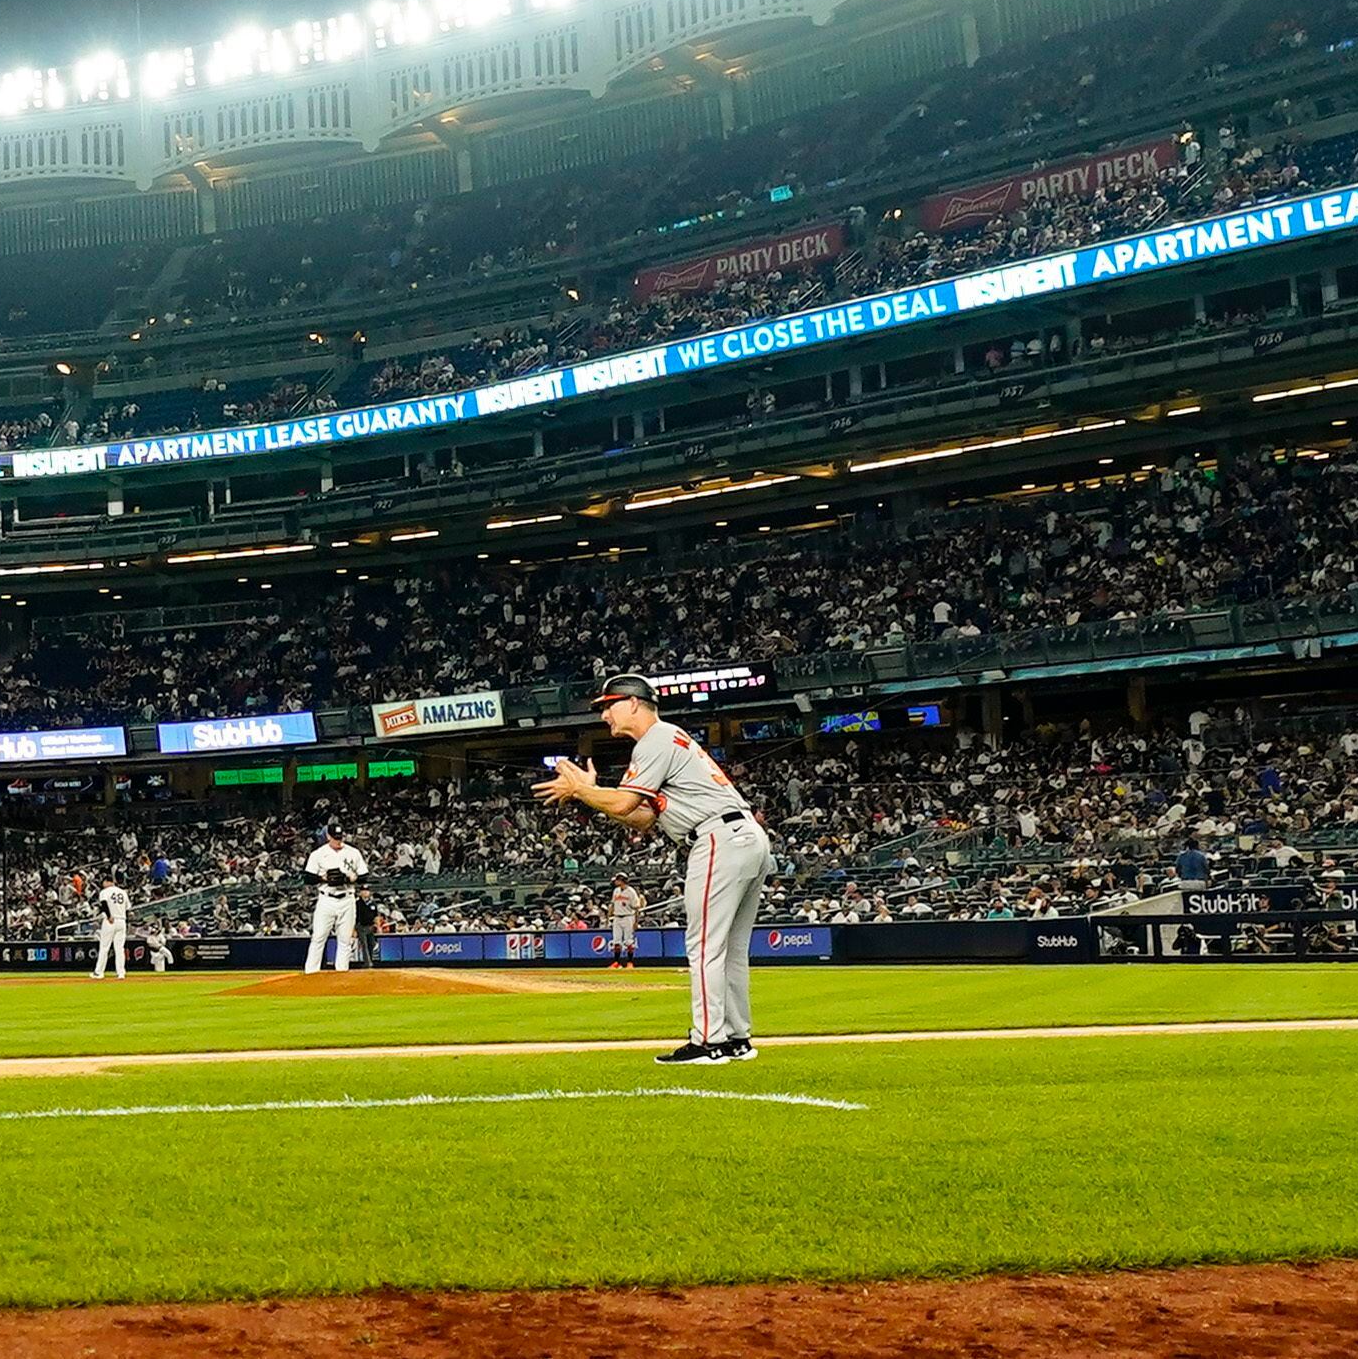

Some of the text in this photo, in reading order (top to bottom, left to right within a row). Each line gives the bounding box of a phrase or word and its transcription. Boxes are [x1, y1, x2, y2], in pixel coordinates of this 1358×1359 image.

[1021, 148, 1159, 201] PARTY DECK
[716, 232, 829, 277] PARTY DECK
[13, 447, 108, 477] INSURENT
[118, 430, 259, 464] APARTMENT
[264, 419, 331, 450] LEASE
[335, 397, 465, 437] GUARANTY
[476, 371, 564, 416] INSURENT
[574, 347, 669, 395] INSURENT
[678, 340, 718, 369] WE
[722, 320, 807, 360] CLOSE
[810, 305, 865, 341] THE
[871, 291, 946, 328] DEAL
[956, 254, 1078, 310] INSURENT
[1091, 207, 1296, 277] APARTMENT
[385, 710, 416, 729] MIKE'S
[423, 700, 496, 724] AMAZING
[192, 719, 283, 749] StubHub
[435, 942, 462, 956] pepsi
[783, 932, 813, 949] pepsi
[1037, 935, 1078, 948] StubHub
